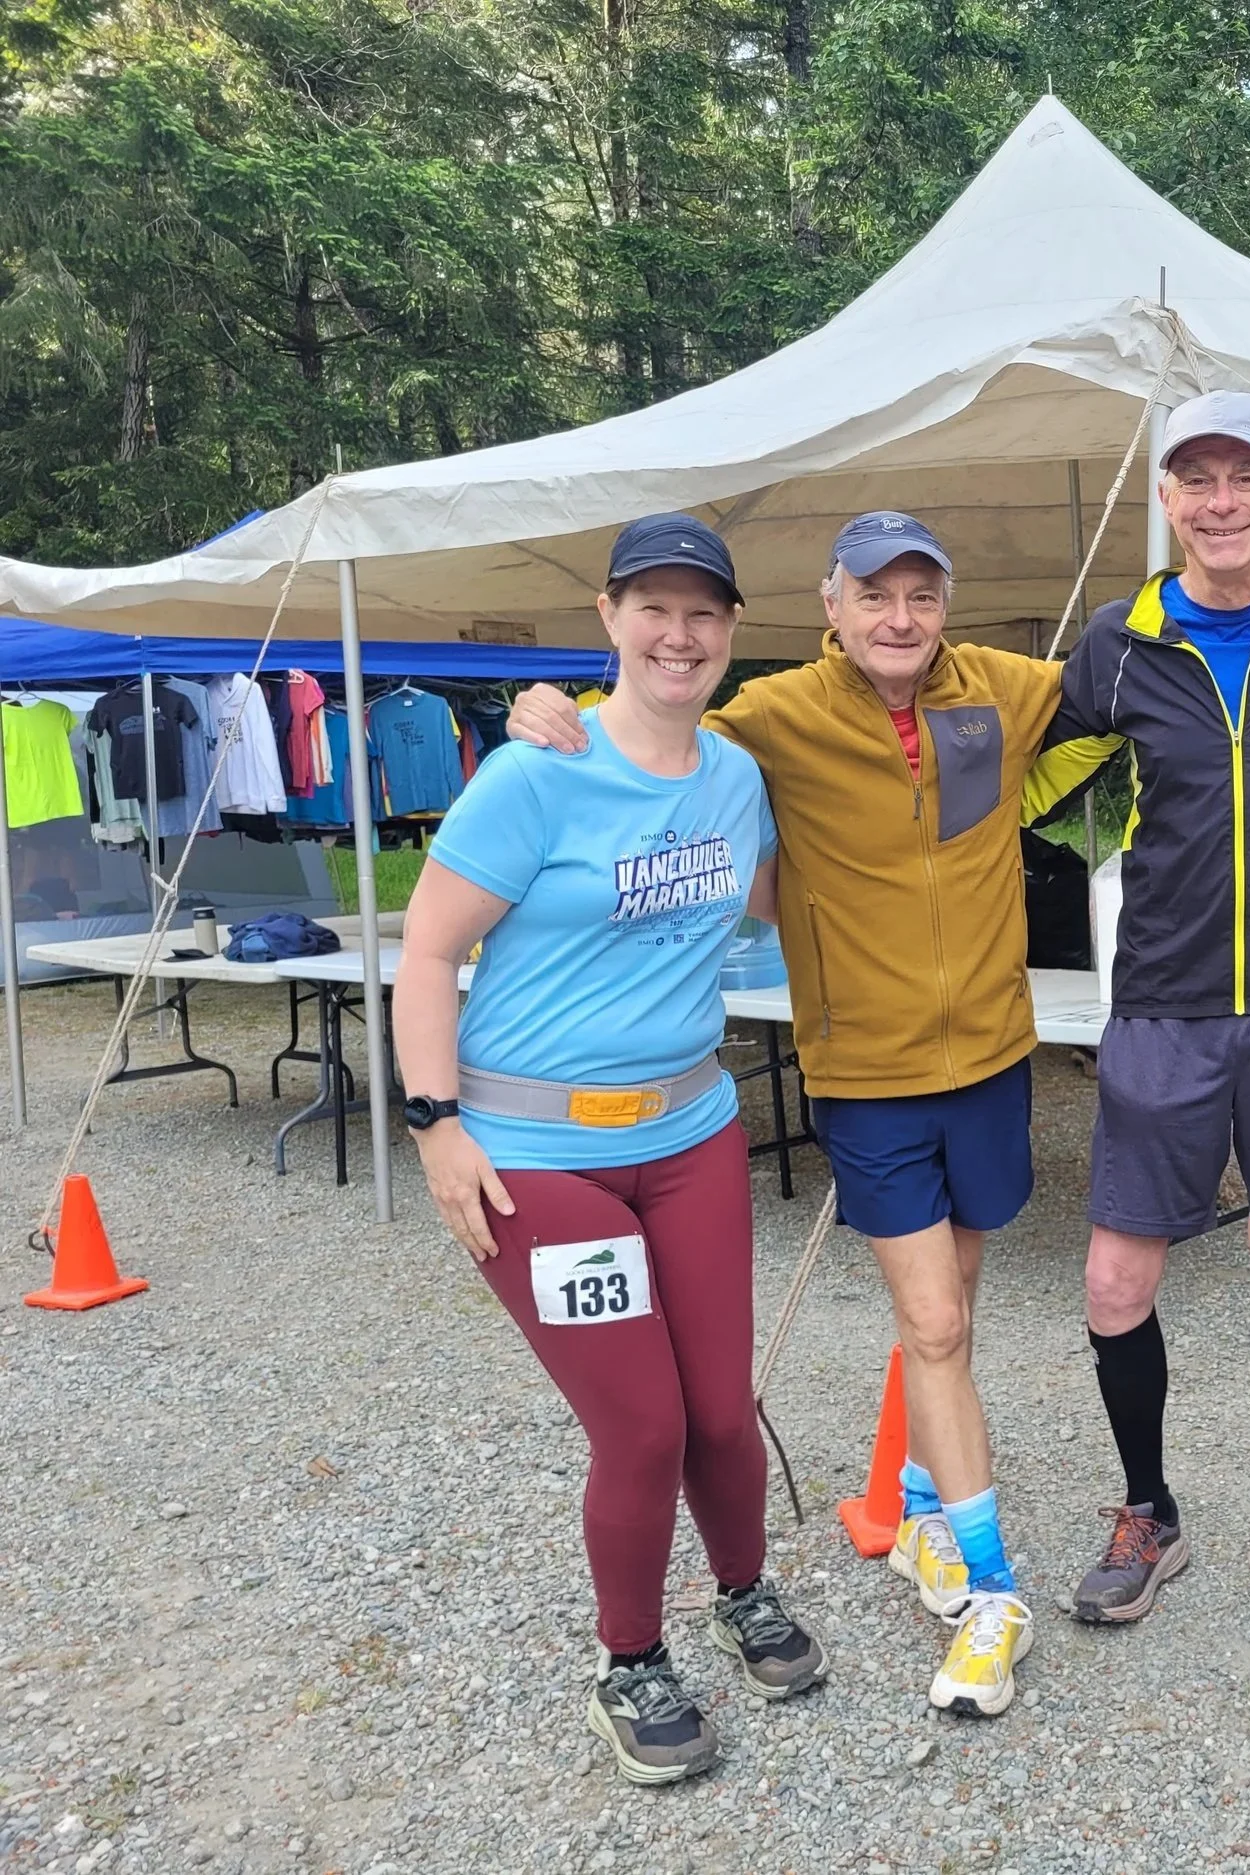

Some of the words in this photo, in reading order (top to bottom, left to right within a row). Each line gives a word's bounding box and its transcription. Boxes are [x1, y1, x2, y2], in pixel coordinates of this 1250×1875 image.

[614, 837, 734, 894] VANCOUVER
[614, 867, 739, 922] MARATHON
[558, 1272, 630, 1318] 133
